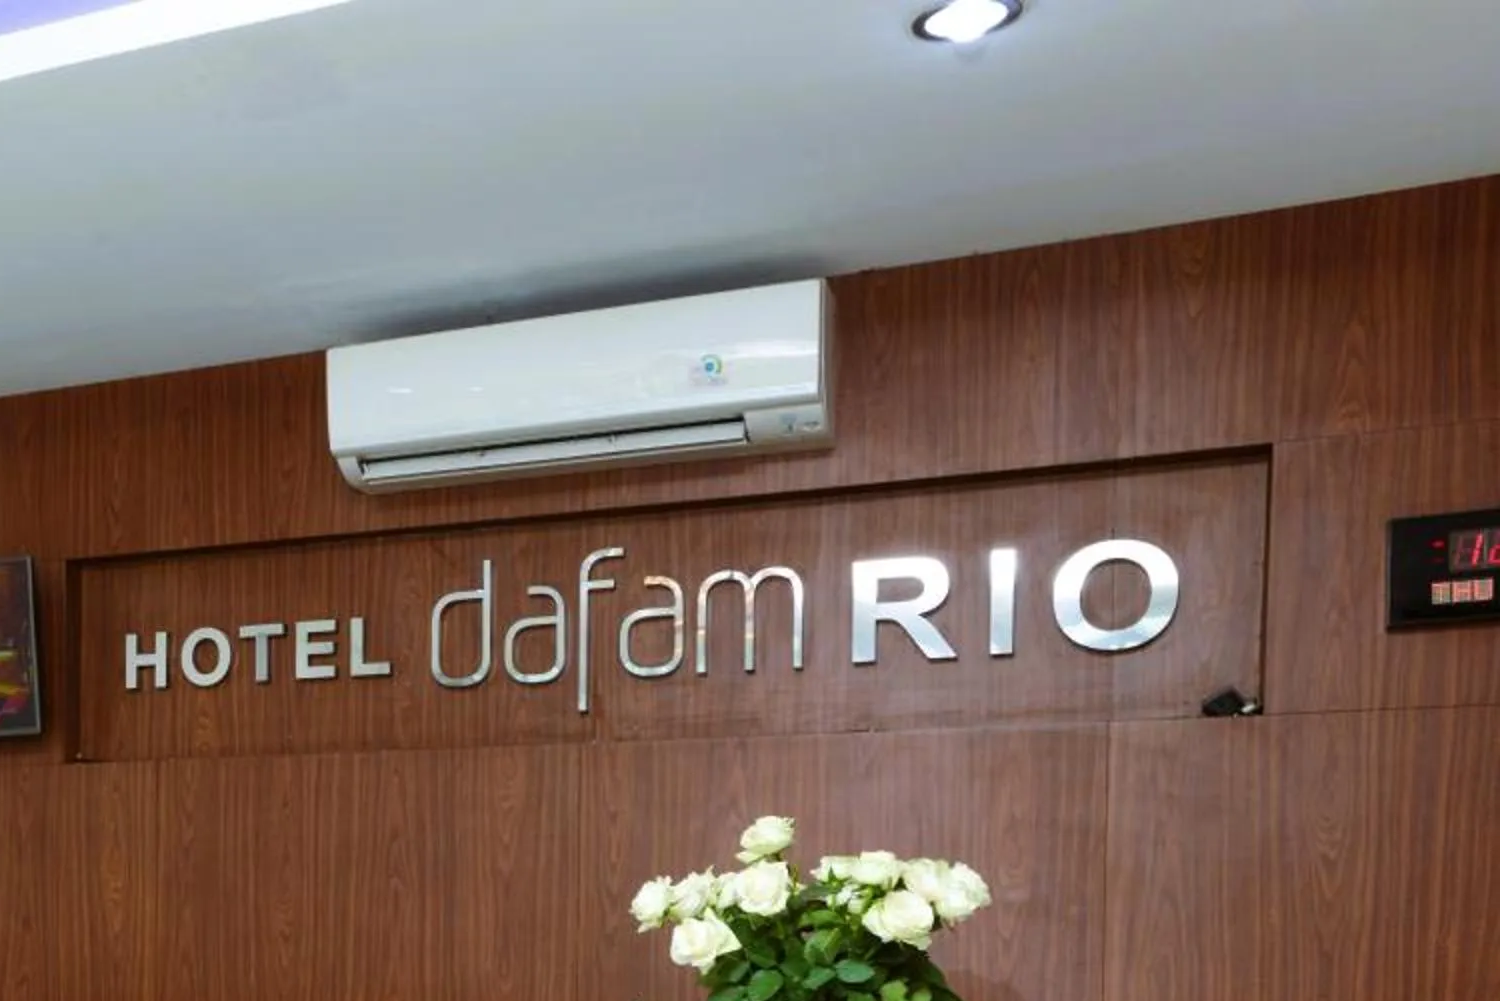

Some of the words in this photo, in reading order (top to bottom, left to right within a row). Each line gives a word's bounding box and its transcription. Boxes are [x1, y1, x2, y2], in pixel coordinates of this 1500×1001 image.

[125, 617, 391, 689] HOTEL
[431, 547, 805, 712] dafam
[852, 539, 1179, 663] RIO
[1431, 578, 1493, 605] THU
